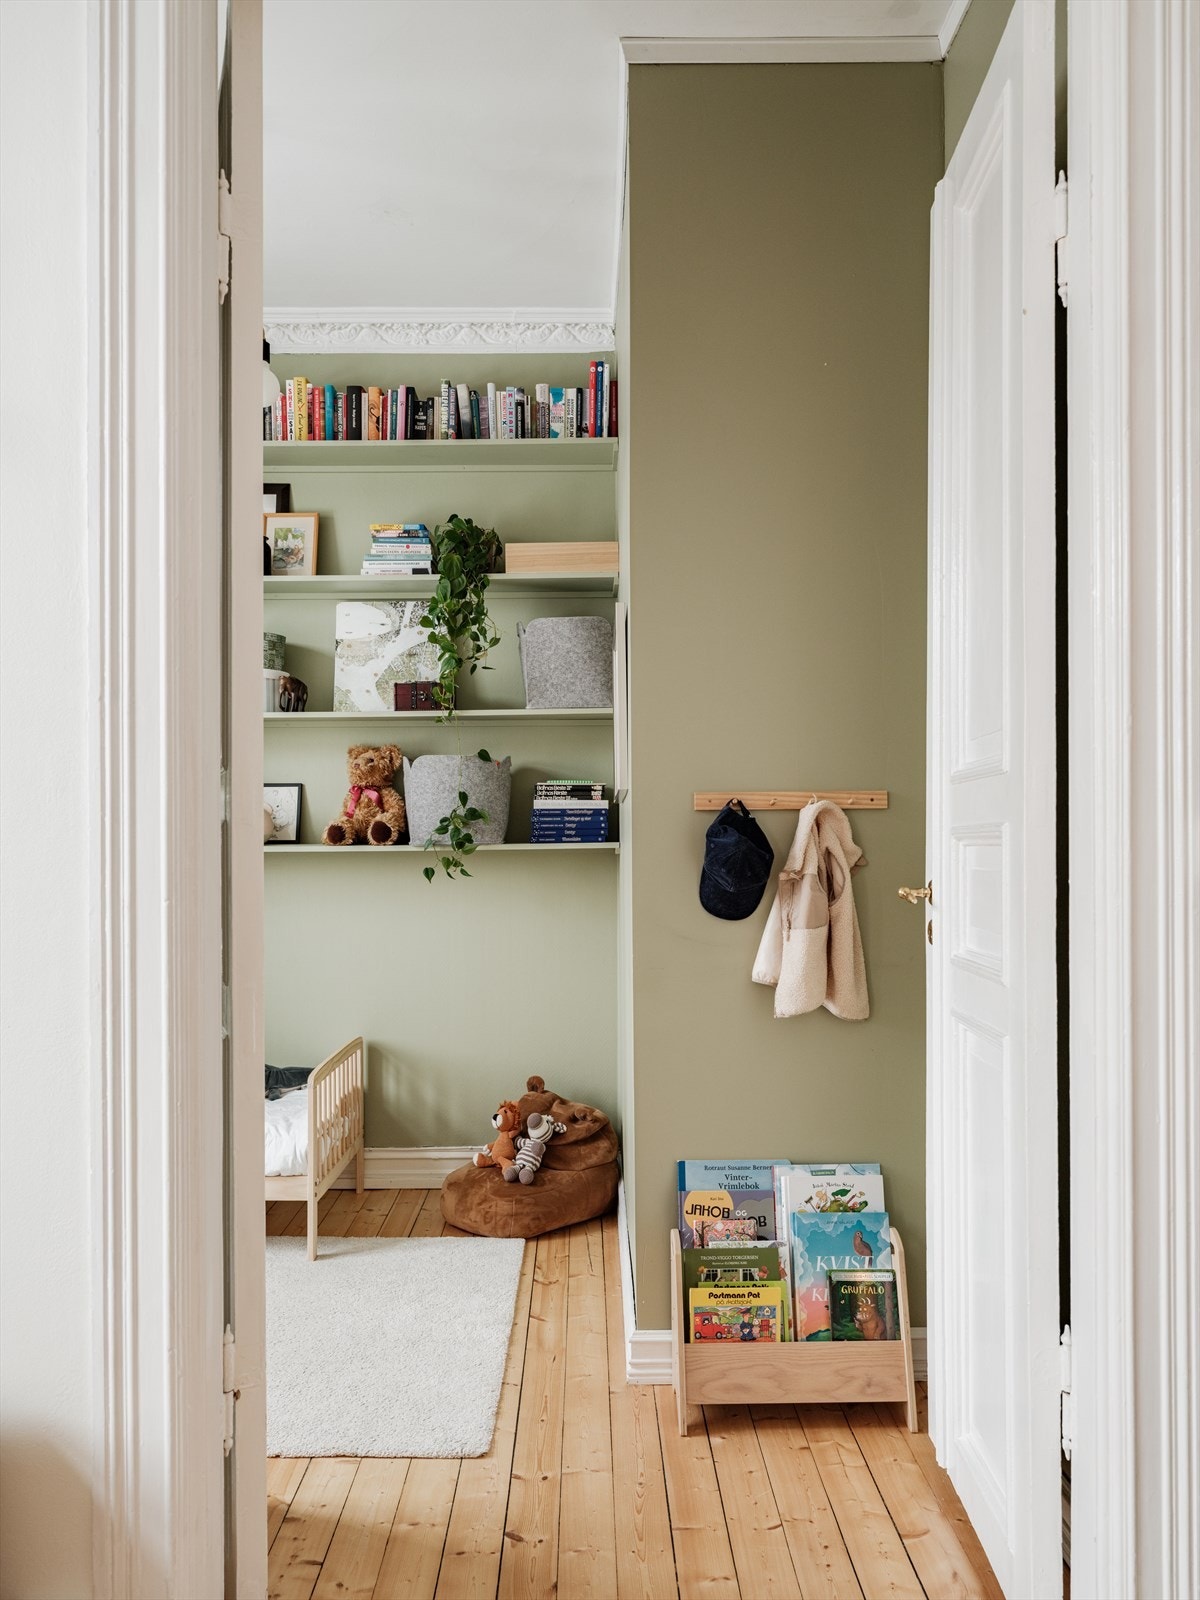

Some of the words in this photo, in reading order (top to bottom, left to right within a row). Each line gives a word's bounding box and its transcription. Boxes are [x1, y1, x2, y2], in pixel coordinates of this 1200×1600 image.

[718, 1182, 760, 1190] Vrimlebok
[685, 1204, 731, 1219] JAKOB
[816, 1255, 875, 1271] KVIST
[747, 1291, 761, 1299] Pat
[841, 1284, 885, 1295] GRUFFALO
